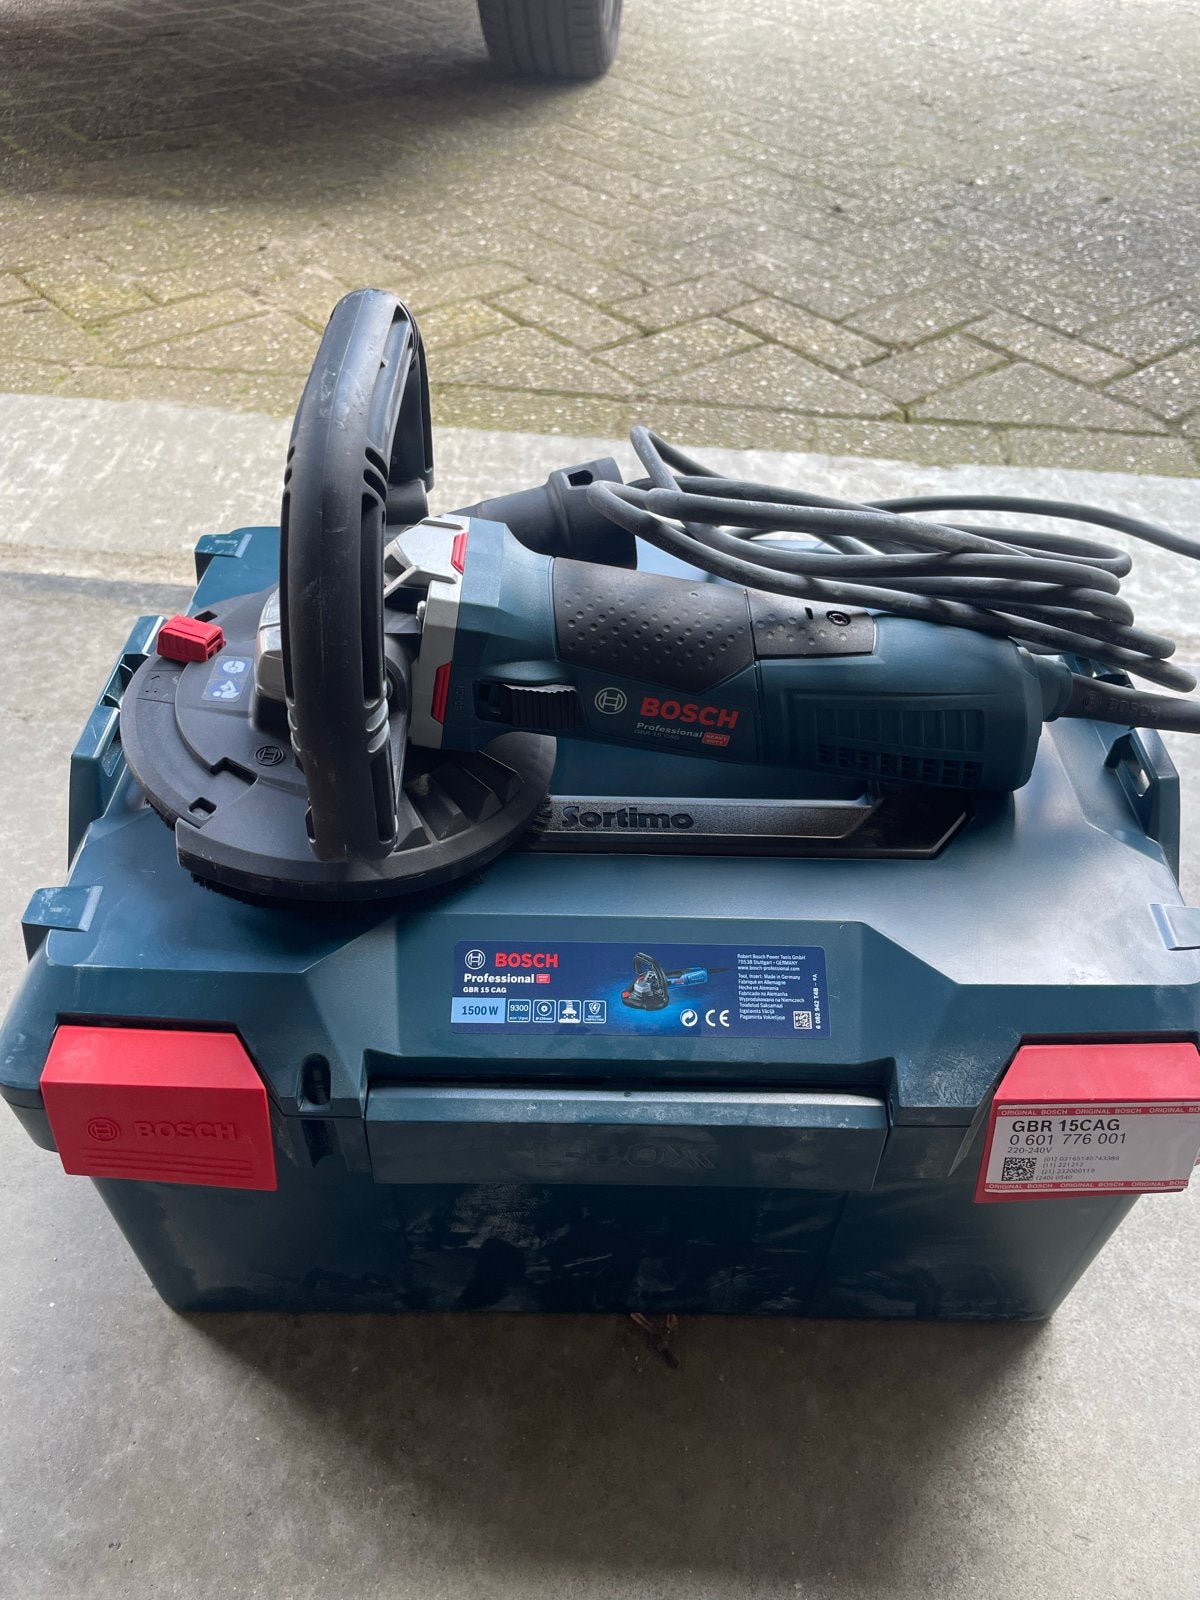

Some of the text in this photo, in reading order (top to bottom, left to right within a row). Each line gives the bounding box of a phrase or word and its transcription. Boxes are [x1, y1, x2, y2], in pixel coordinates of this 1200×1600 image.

[639, 697, 740, 729] BOSCH
[636, 722, 703, 738] Professional
[561, 805, 694, 829] Sortimo
[495, 952, 559, 968] BOSCH
[464, 973, 534, 984] Professional
[491, 986, 507, 994] CAG
[462, 1005, 499, 1015] 1500 W
[510, 1004, 529, 1012] 9300
[1001, 1108, 1037, 1116] ORIGINAL
[1041, 1108, 1068, 1116] BOSCH
[1115, 1107, 1142, 1115] BOSCH
[134, 1120, 237, 1141] BOSCH
[1012, 1118, 1121, 1133] GBR 15CAG
[1009, 1132, 1126, 1146] 0 601 776 001
[1007, 1146, 1053, 1154] 220-240V
